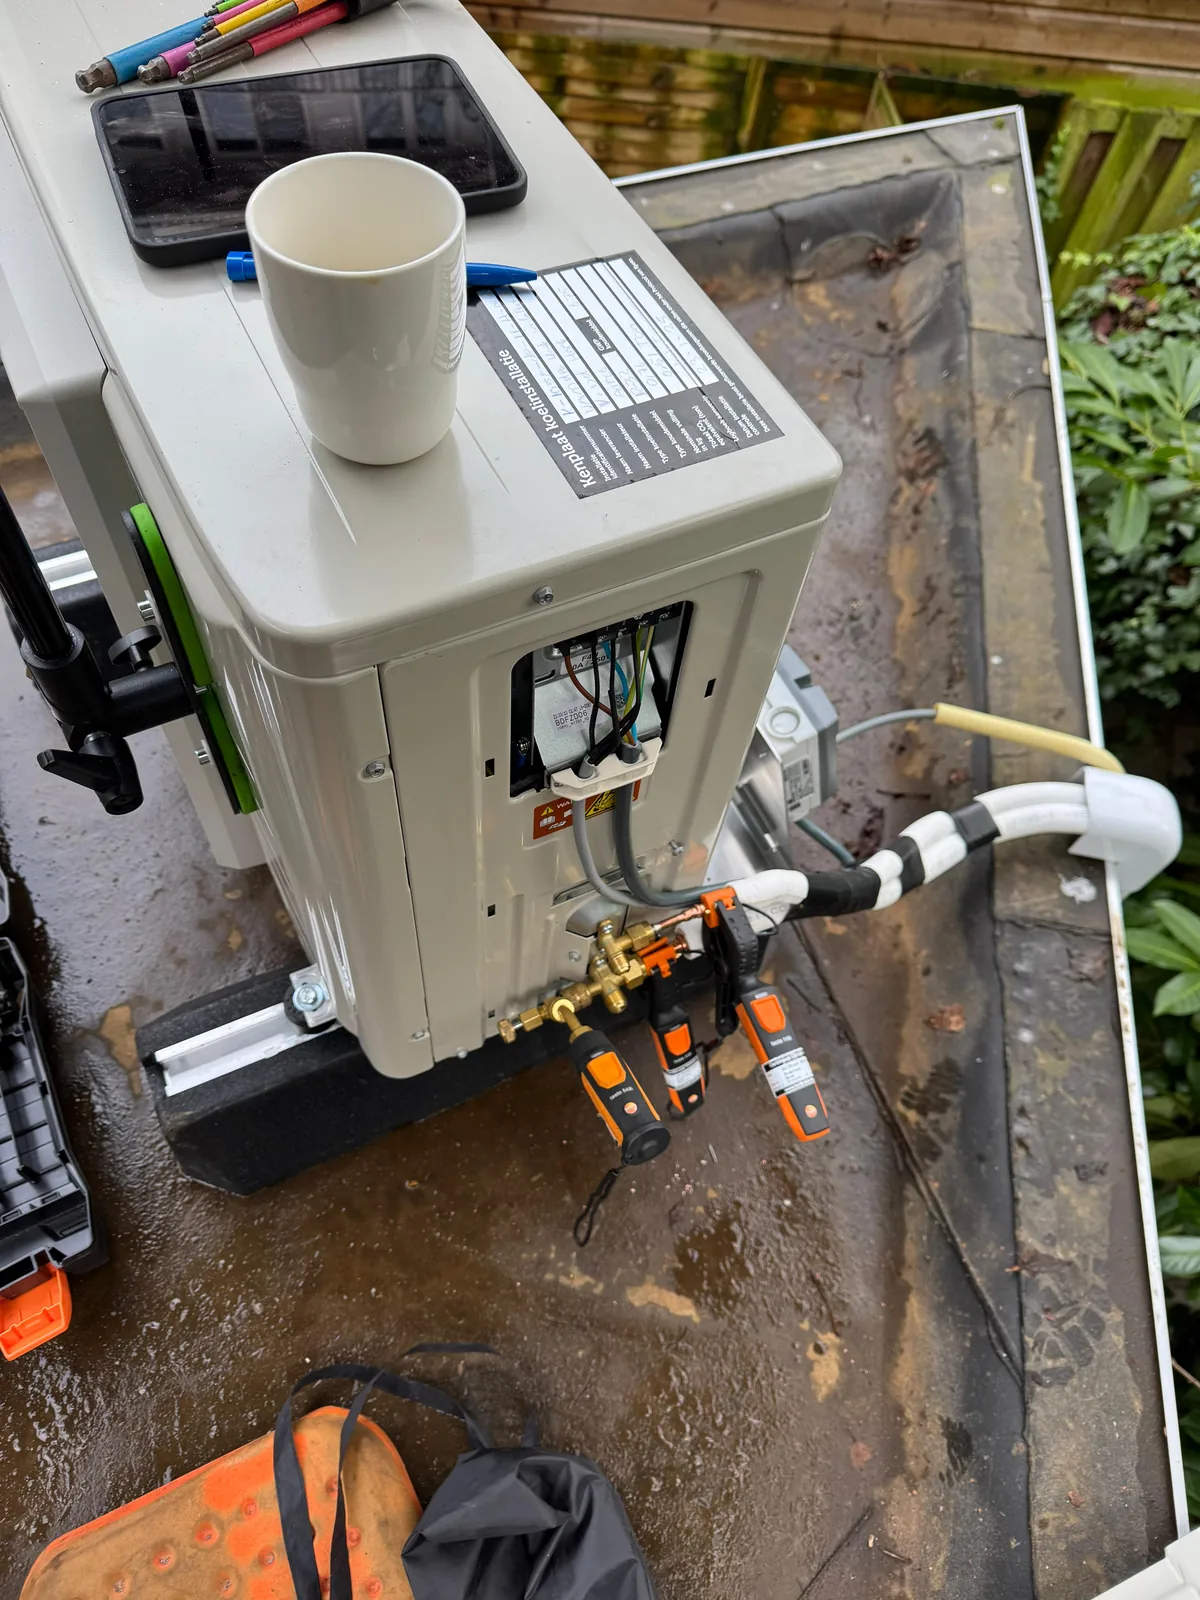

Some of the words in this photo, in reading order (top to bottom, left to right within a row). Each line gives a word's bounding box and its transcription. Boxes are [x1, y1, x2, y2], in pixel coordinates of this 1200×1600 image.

[586, 319, 612, 350] koudemiddel
[499, 349, 559, 432] koelinstallatie
[667, 409, 682, 428] vulling
[692, 405, 706, 419] (ton)
[718, 396, 740, 421] installatie
[631, 414, 660, 450] koelinstallatie
[649, 410, 678, 445] koudemiddel
[702, 418, 725, 446] equivalent
[737, 419, 753, 438] Datum
[741, 414, 760, 436] controle
[759, 420, 770, 433] Deze
[599, 429, 622, 458] leverancier
[616, 423, 640, 453] installateur
[680, 428, 702, 454] Nominale
[695, 437, 703, 446] kg
[702, 431, 718, 449] Totaal
[551, 431, 597, 488] Kenplaat
[579, 425, 618, 479] identificatienummer
[637, 452, 652, 469] Naam
[657, 449, 669, 464] Type
[675, 444, 687, 458] Type
[590, 454, 611, 482] Installatie
[619, 457, 633, 475] Naam
